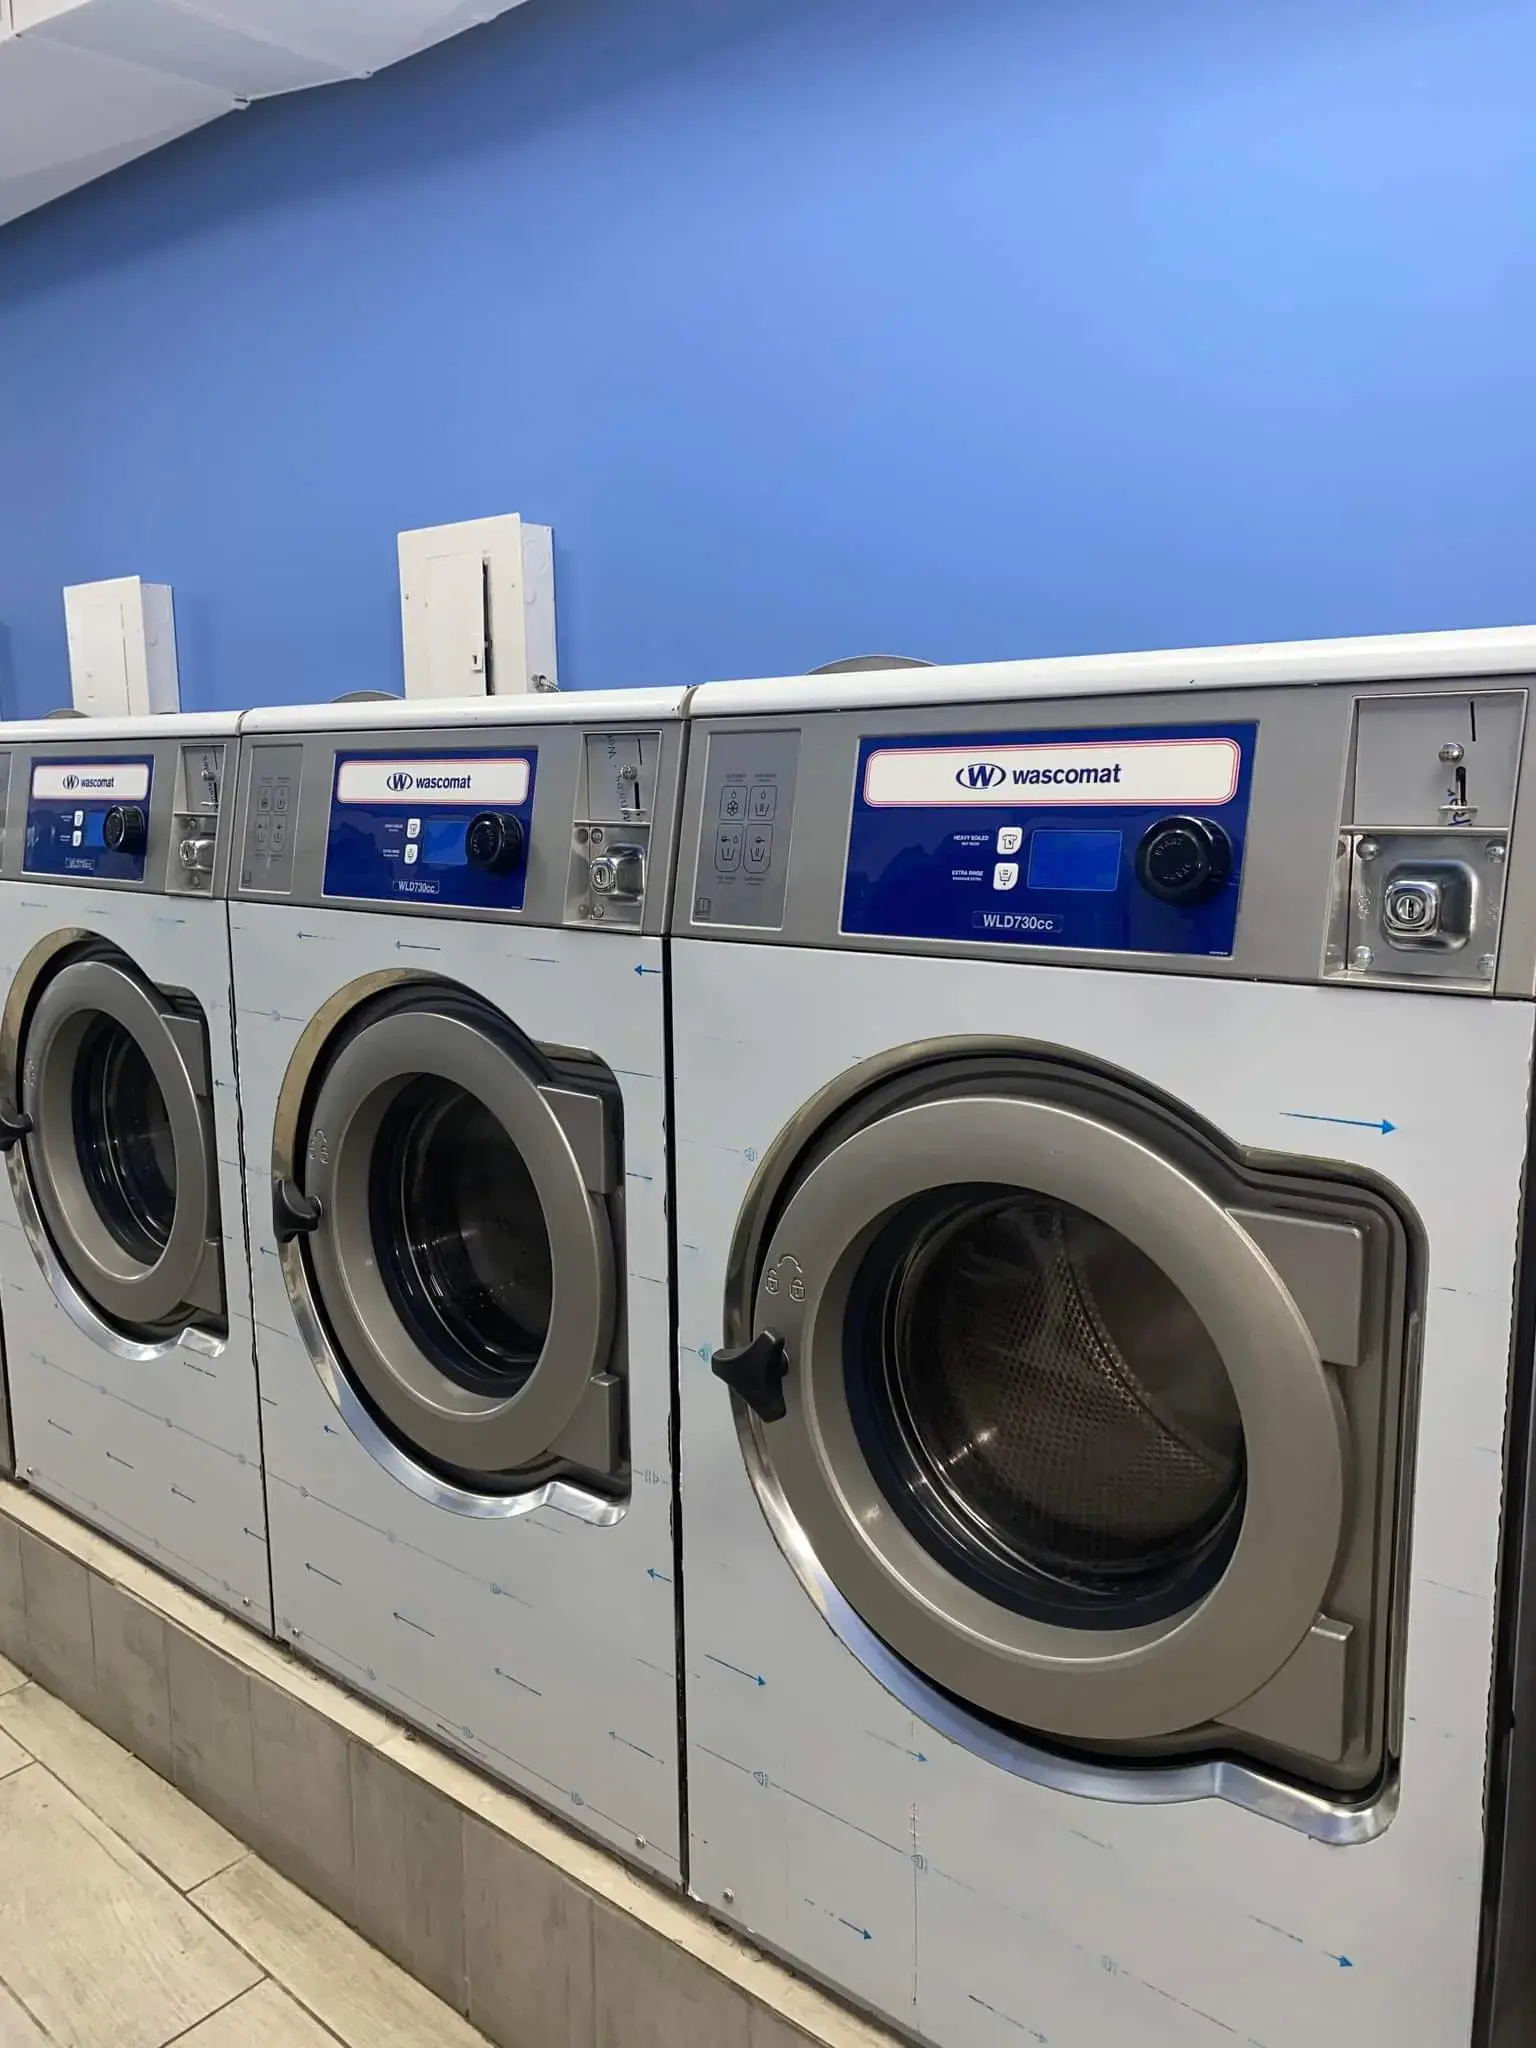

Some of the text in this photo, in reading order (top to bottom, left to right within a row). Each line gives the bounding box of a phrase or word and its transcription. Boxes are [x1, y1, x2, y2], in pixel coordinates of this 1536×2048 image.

[415, 774, 472, 789] wascomat
[1012, 763, 1122, 785] wascomat
[80, 776, 115, 788] wascomat
[398, 880, 436, 893] WLD730cc
[983, 914, 1054, 930] WLD730cc
